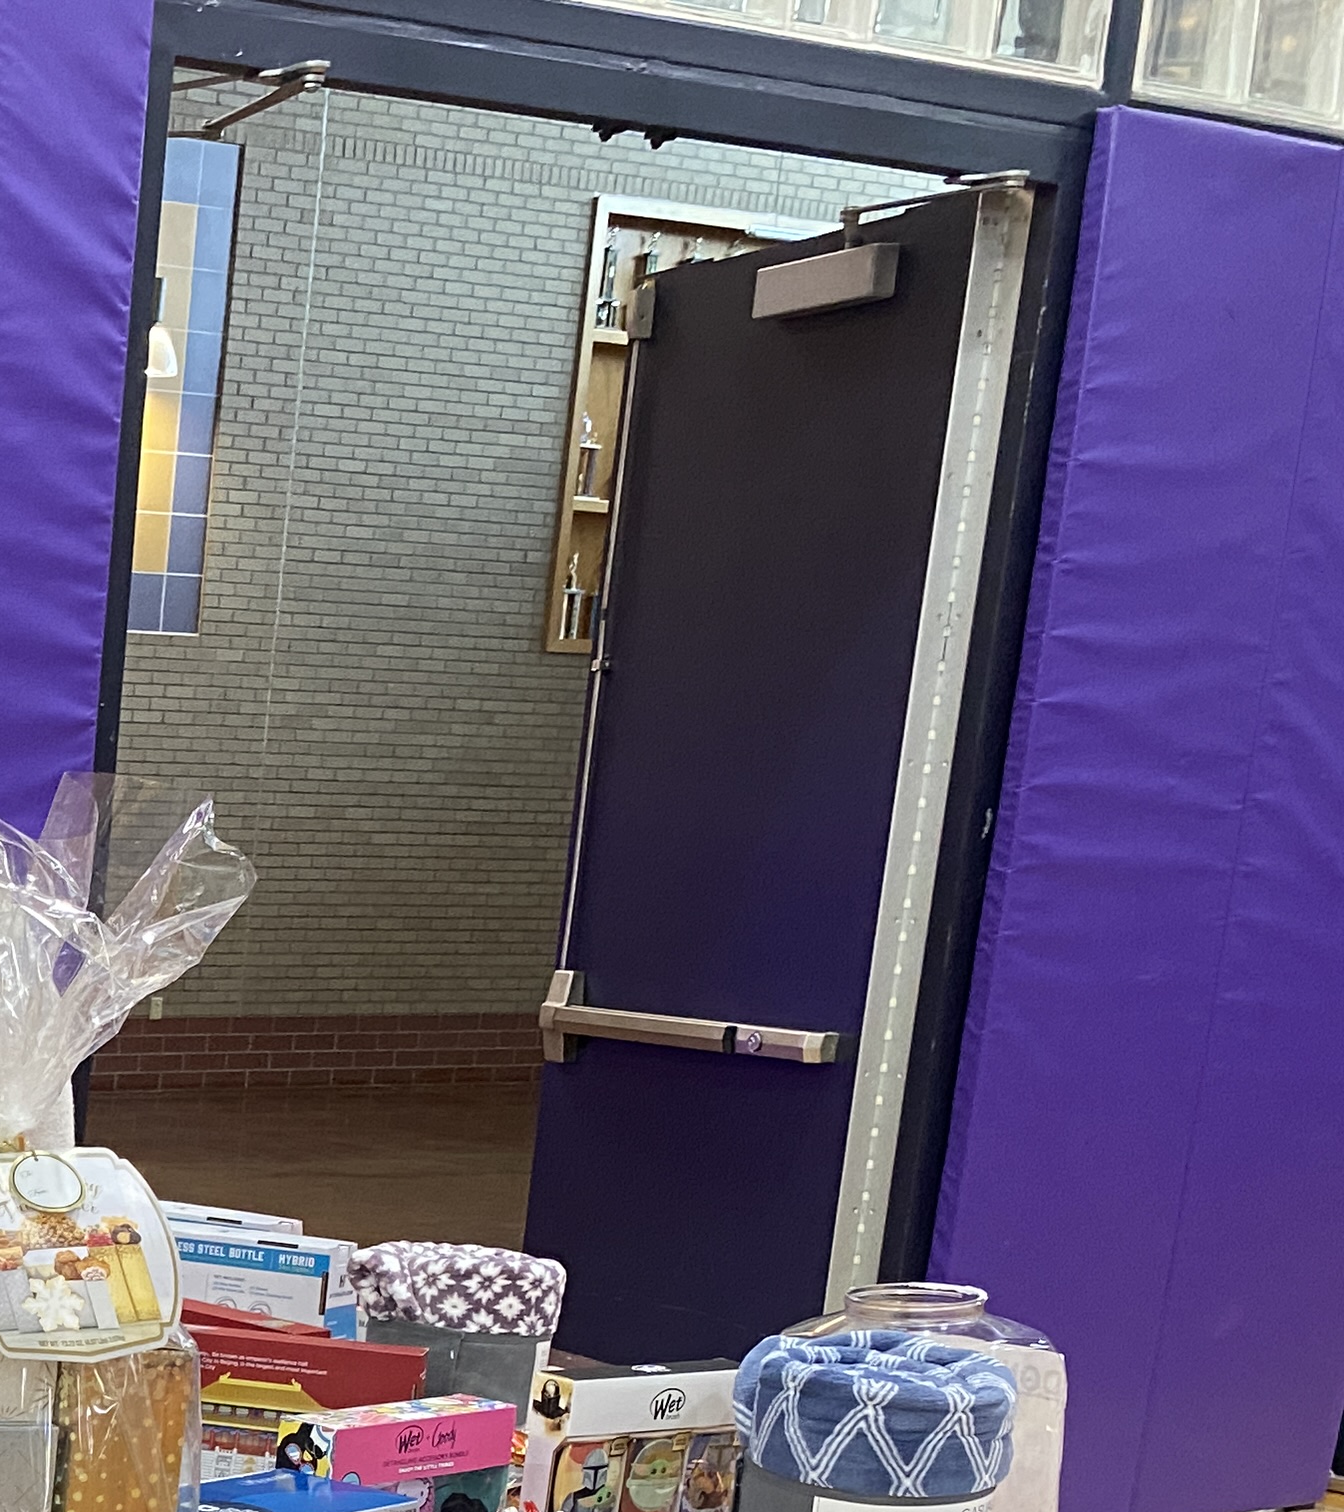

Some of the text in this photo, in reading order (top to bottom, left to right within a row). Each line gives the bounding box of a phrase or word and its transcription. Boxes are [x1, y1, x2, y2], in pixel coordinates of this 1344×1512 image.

[197, 1244, 226, 1257] STEEL
[228, 1247, 265, 1262] BOTTLE
[278, 1253, 315, 1268] HYBRID
[653, 1393, 683, 1421] Wet
[398, 1430, 423, 1454] Wet
